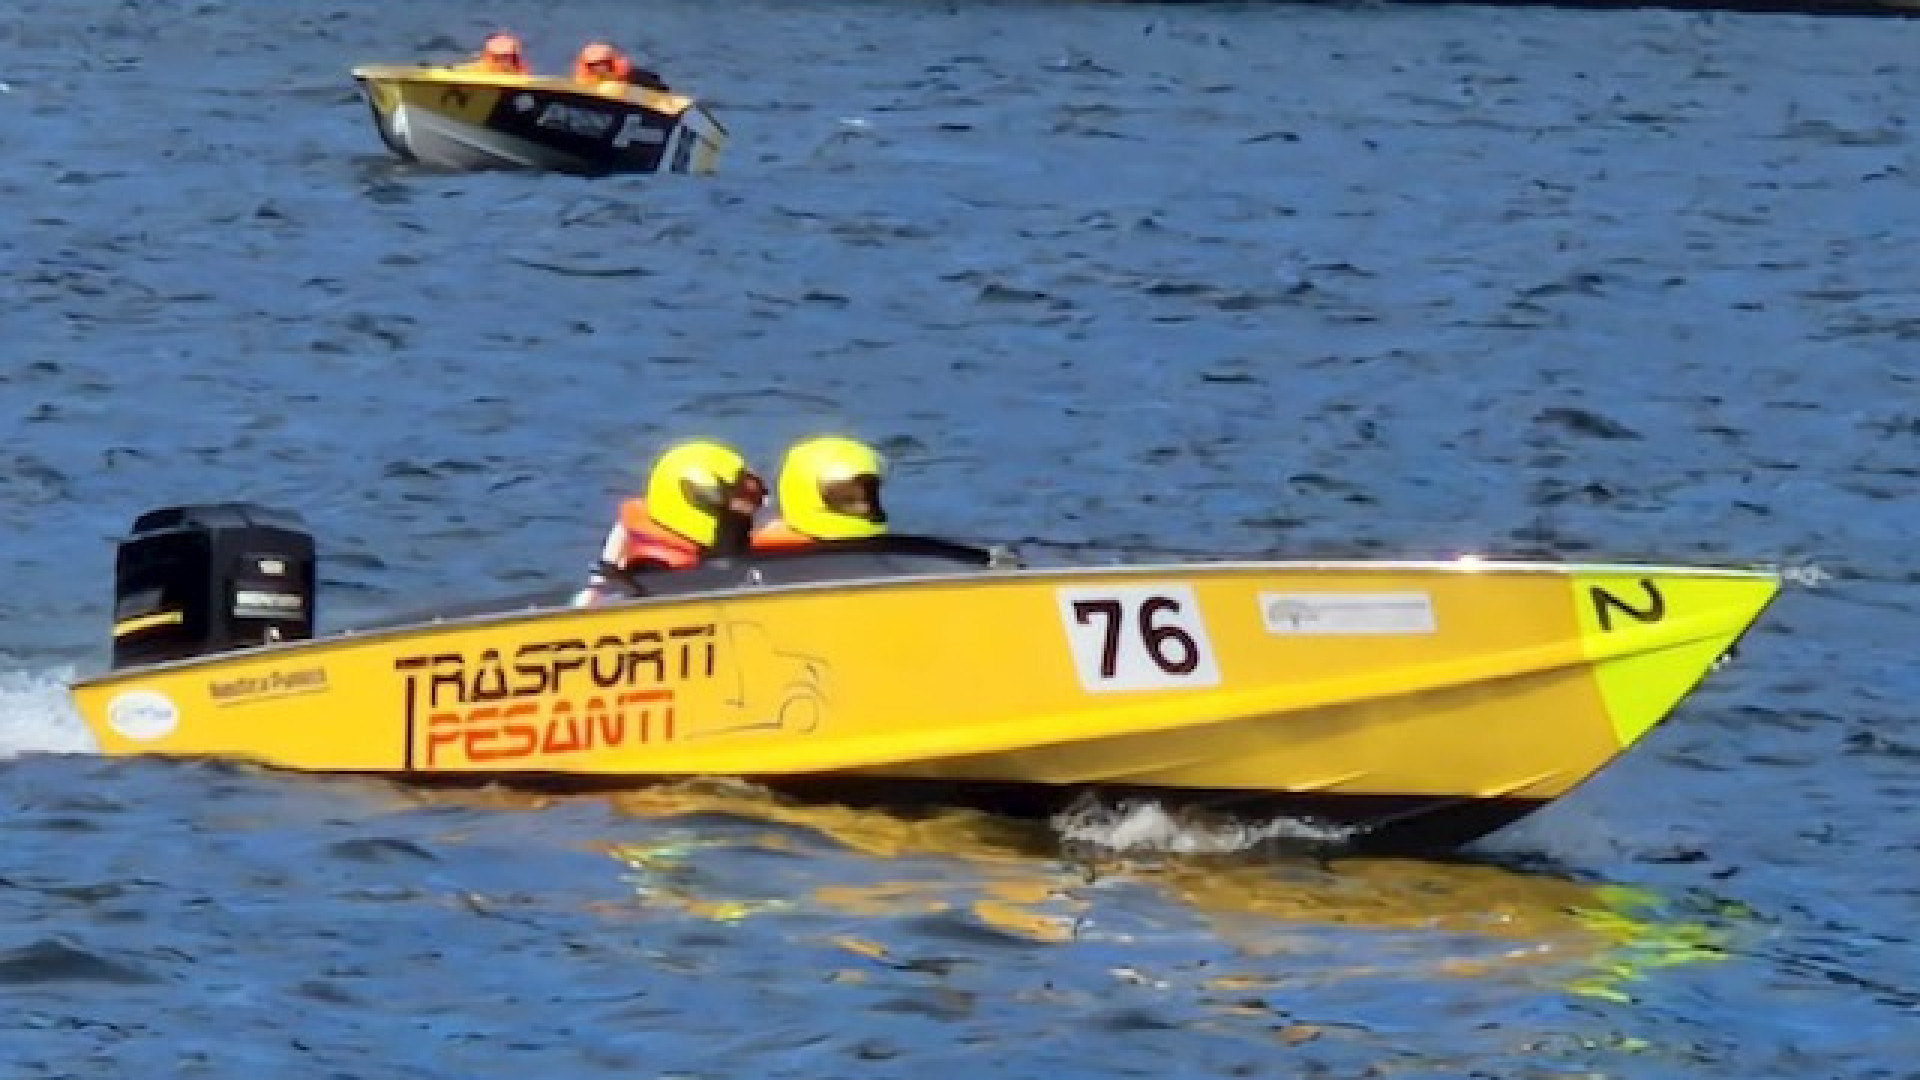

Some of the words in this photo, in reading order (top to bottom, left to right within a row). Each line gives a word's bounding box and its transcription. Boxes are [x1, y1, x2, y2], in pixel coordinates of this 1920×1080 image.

[1072, 595, 1200, 678] 76
[1589, 578, 1664, 633] 2
[395, 623, 715, 769] TRASPORTI
[428, 689, 674, 766] PESANTI
